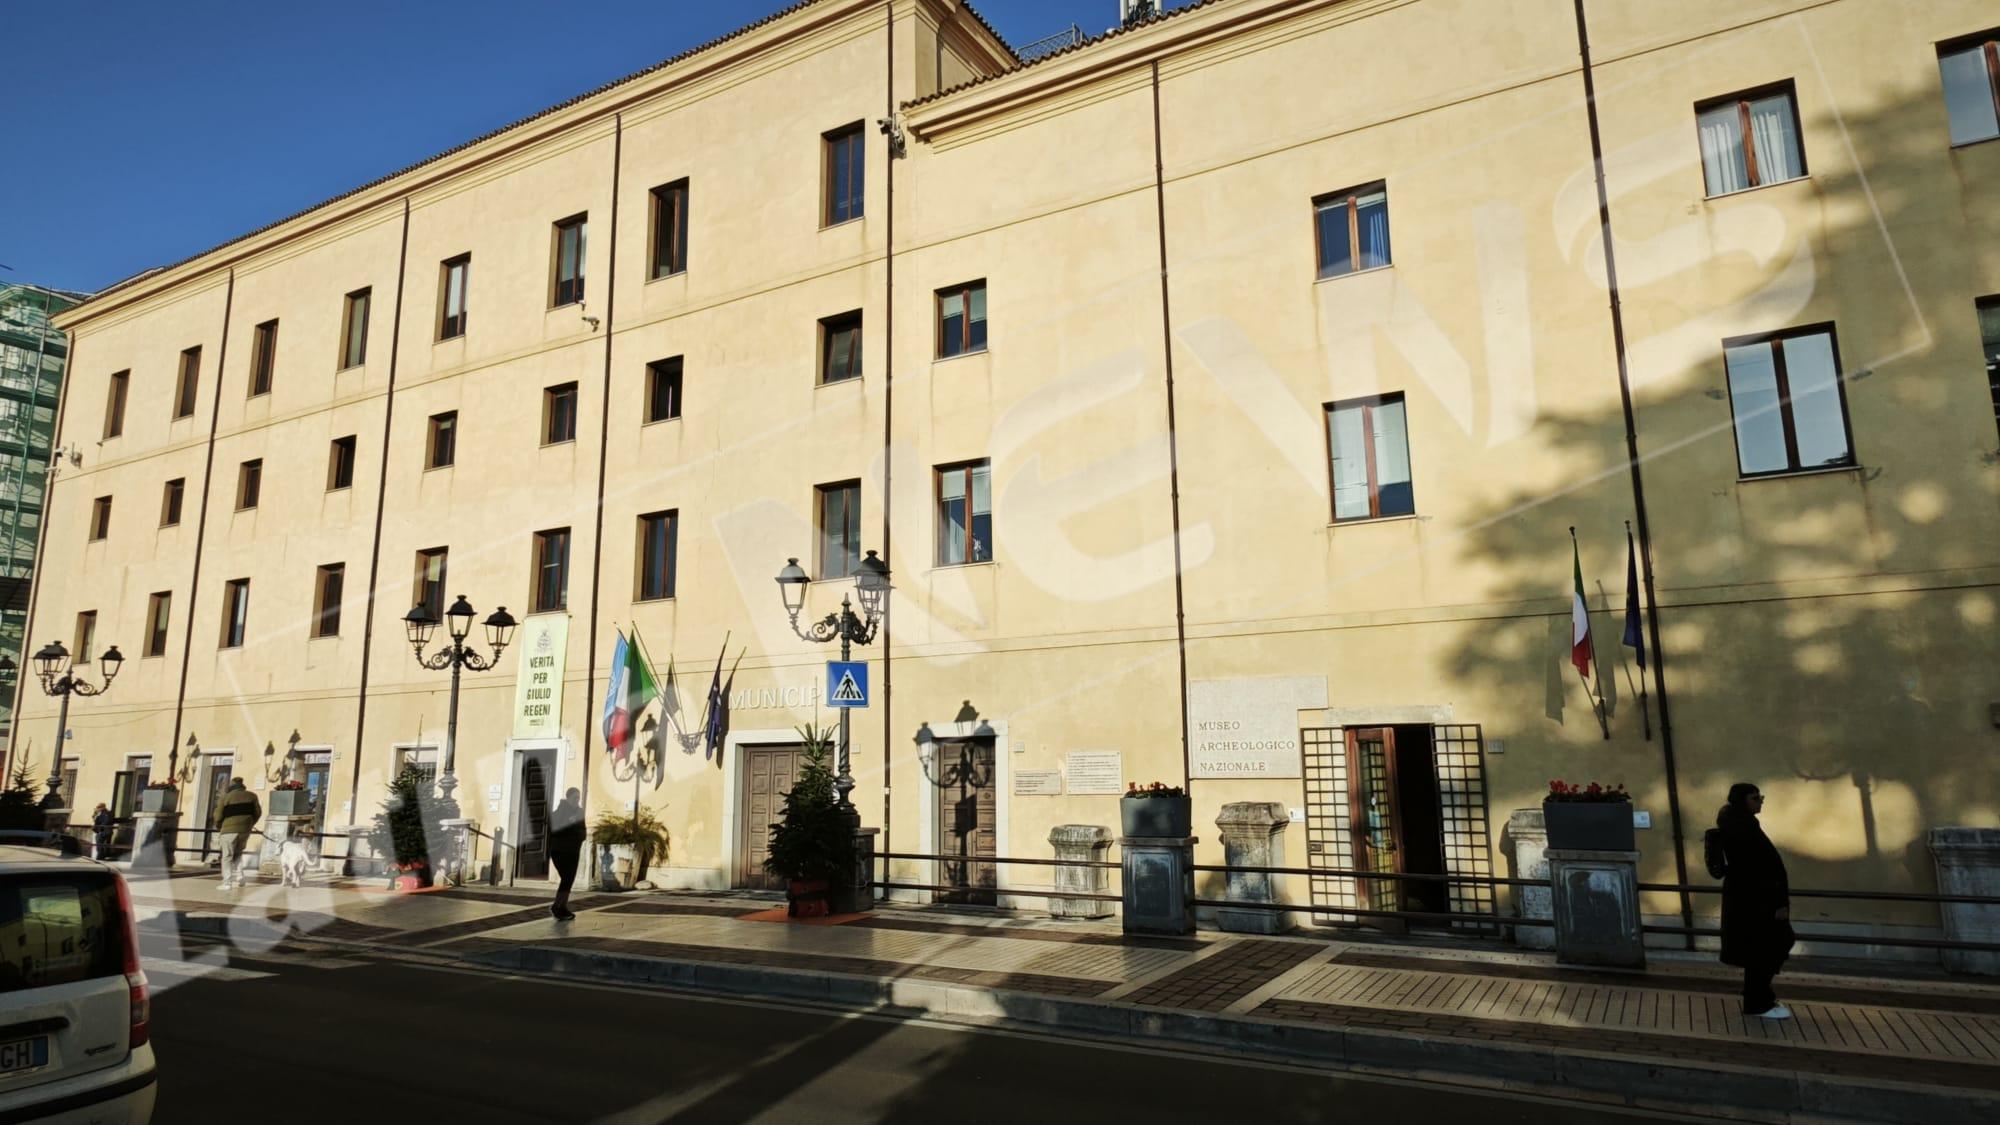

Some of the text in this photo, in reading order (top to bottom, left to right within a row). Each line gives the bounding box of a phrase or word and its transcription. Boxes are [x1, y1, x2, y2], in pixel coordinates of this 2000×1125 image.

[533, 672, 548, 684] PER
[527, 688, 551, 700] GIULIO
[728, 685, 827, 711] MUNICIP
[524, 704, 551, 716] REGENI
[1199, 721, 1241, 731] MUSEO
[1199, 741, 1295, 751] ARCHEOLOGICO
[1200, 762, 1265, 772] NAZIONALE
